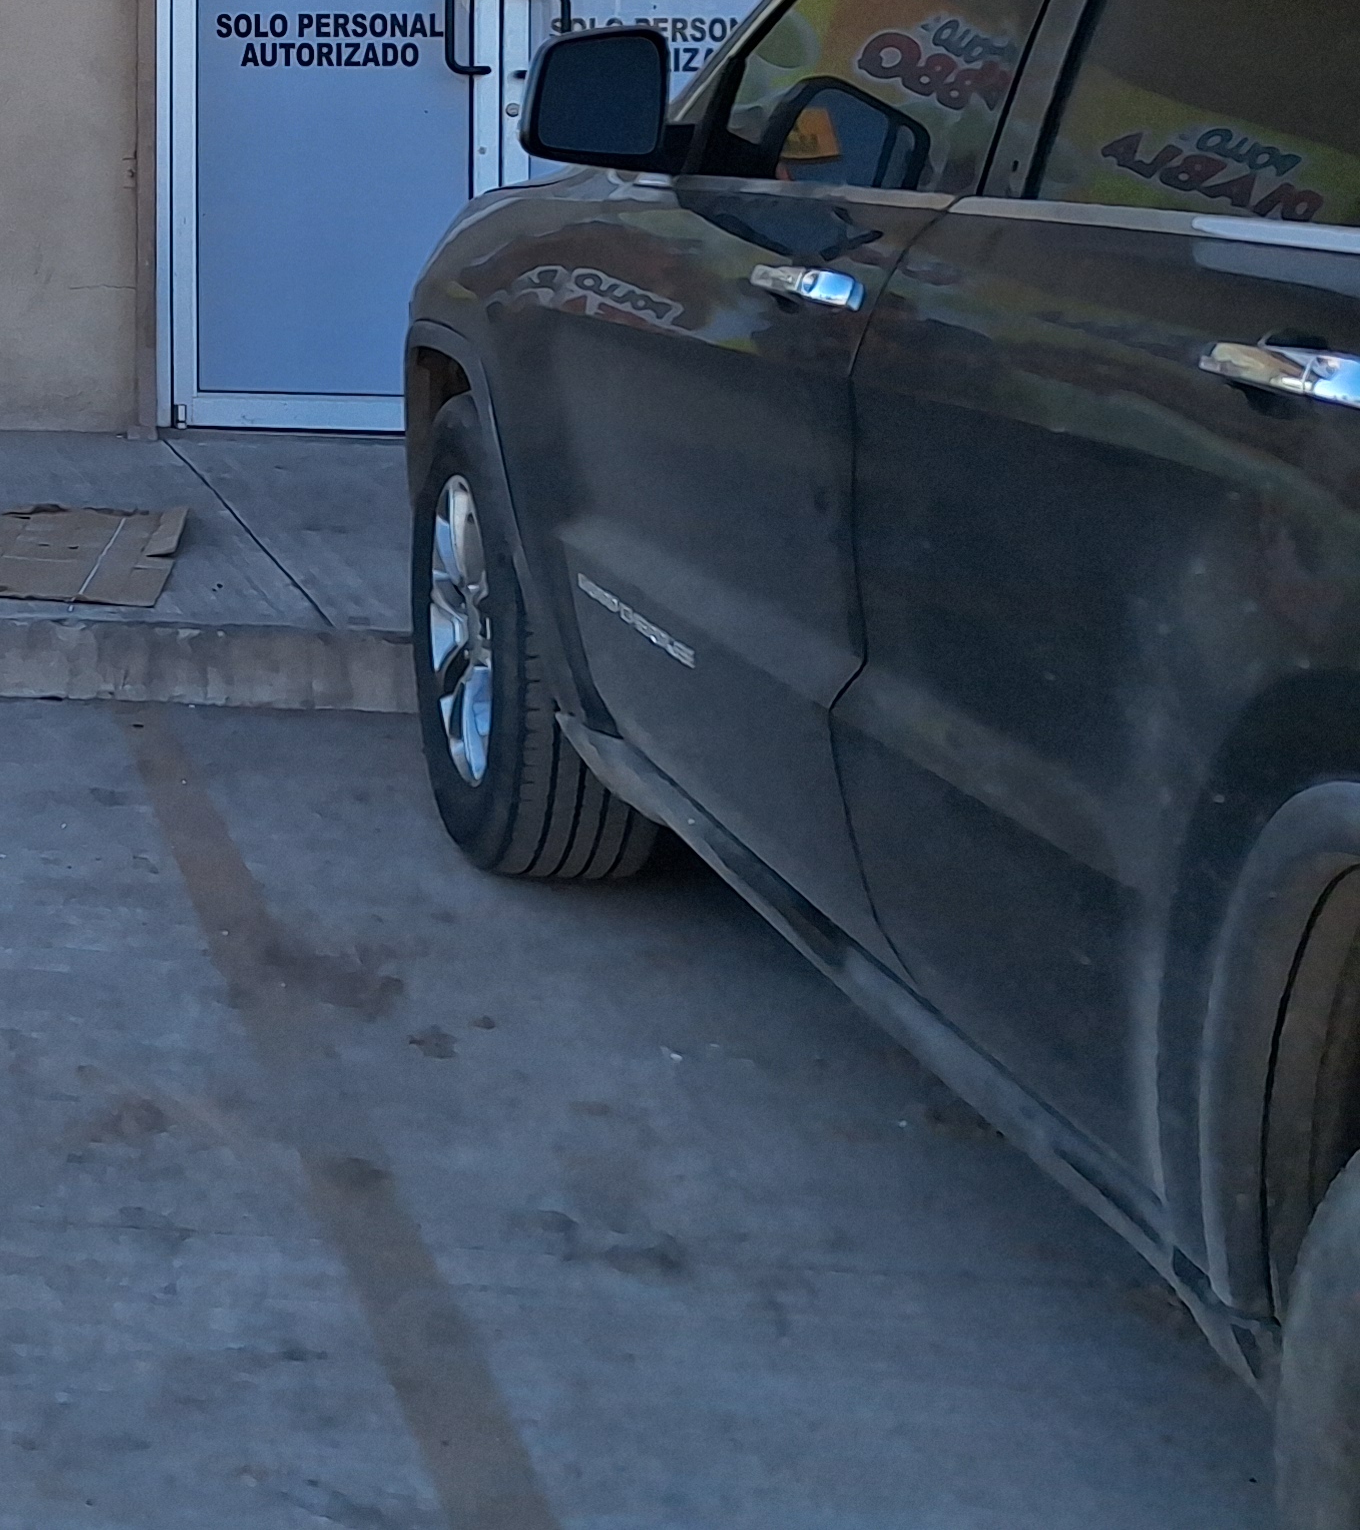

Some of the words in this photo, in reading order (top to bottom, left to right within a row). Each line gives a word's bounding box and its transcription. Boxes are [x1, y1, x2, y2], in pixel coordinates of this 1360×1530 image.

[216, 14, 288, 38] SOLO
[298, 13, 444, 38] PERSONAL
[241, 42, 419, 67] AUTORIZADO
